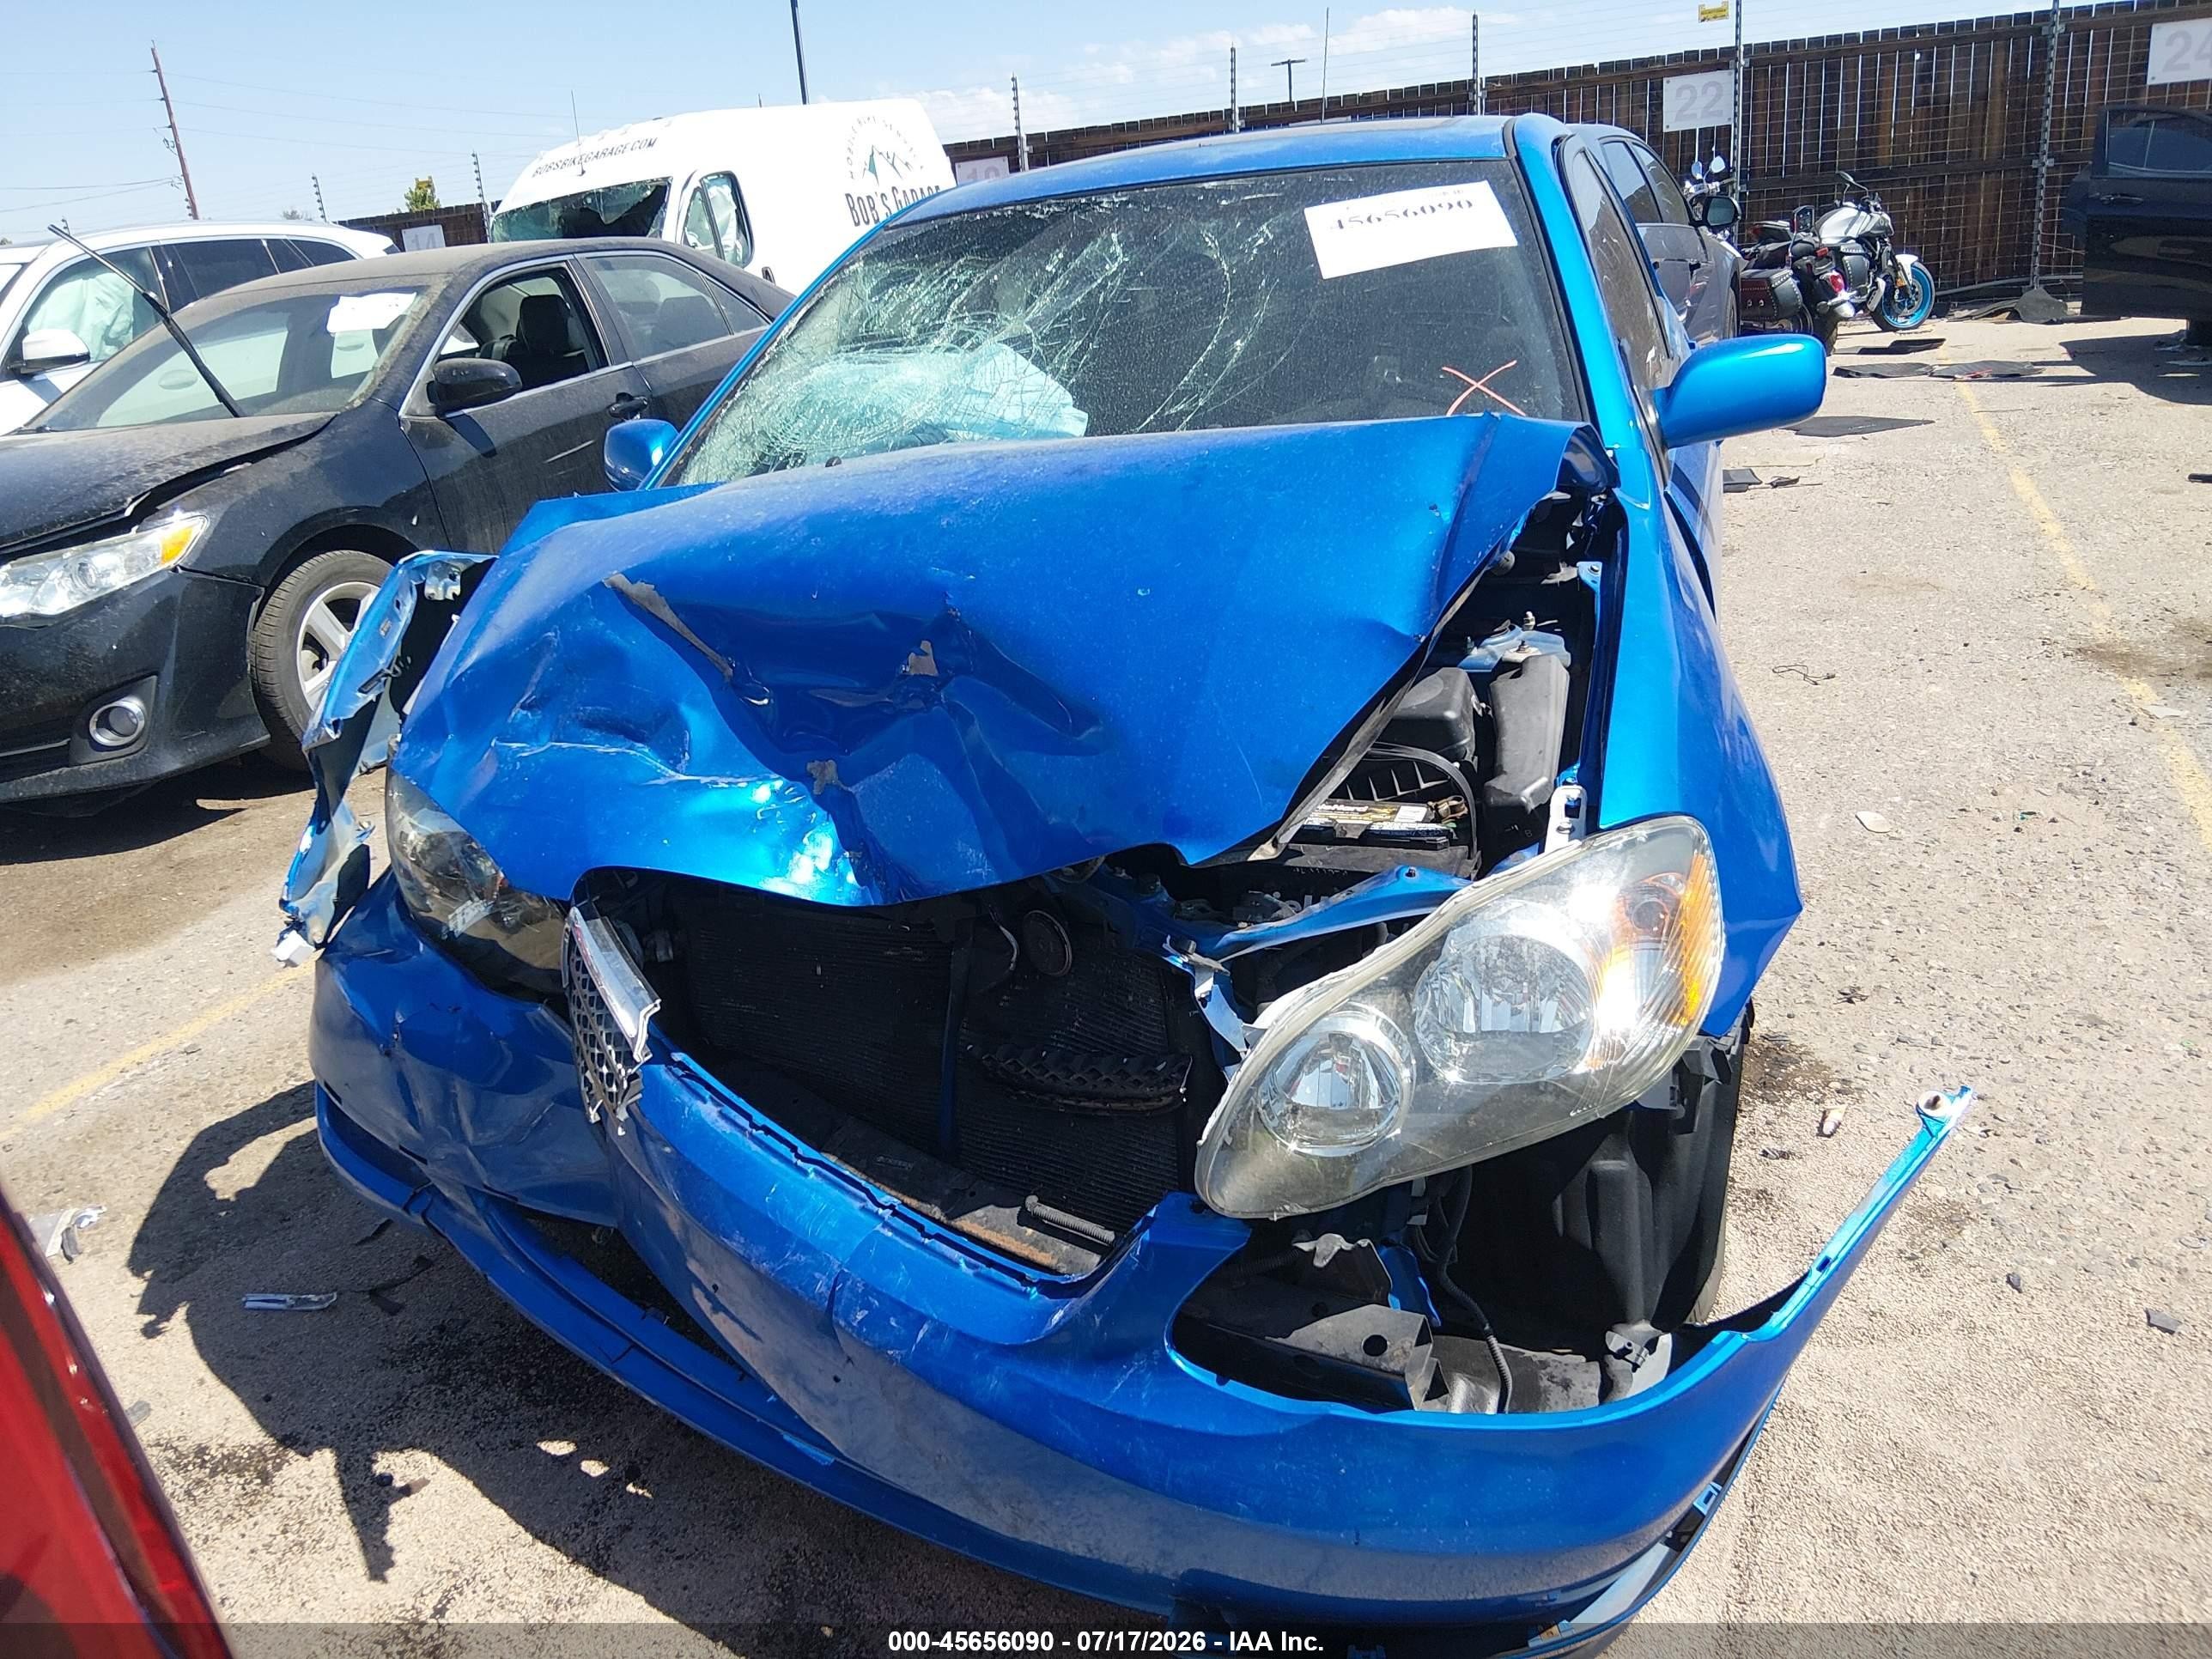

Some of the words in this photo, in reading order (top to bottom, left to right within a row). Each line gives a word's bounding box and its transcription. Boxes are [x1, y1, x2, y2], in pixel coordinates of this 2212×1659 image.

[1675, 81, 1723, 122] 22
[532, 137, 658, 177] BOBSBIKEGARAGECOM
[845, 191, 892, 227] BOB'S
